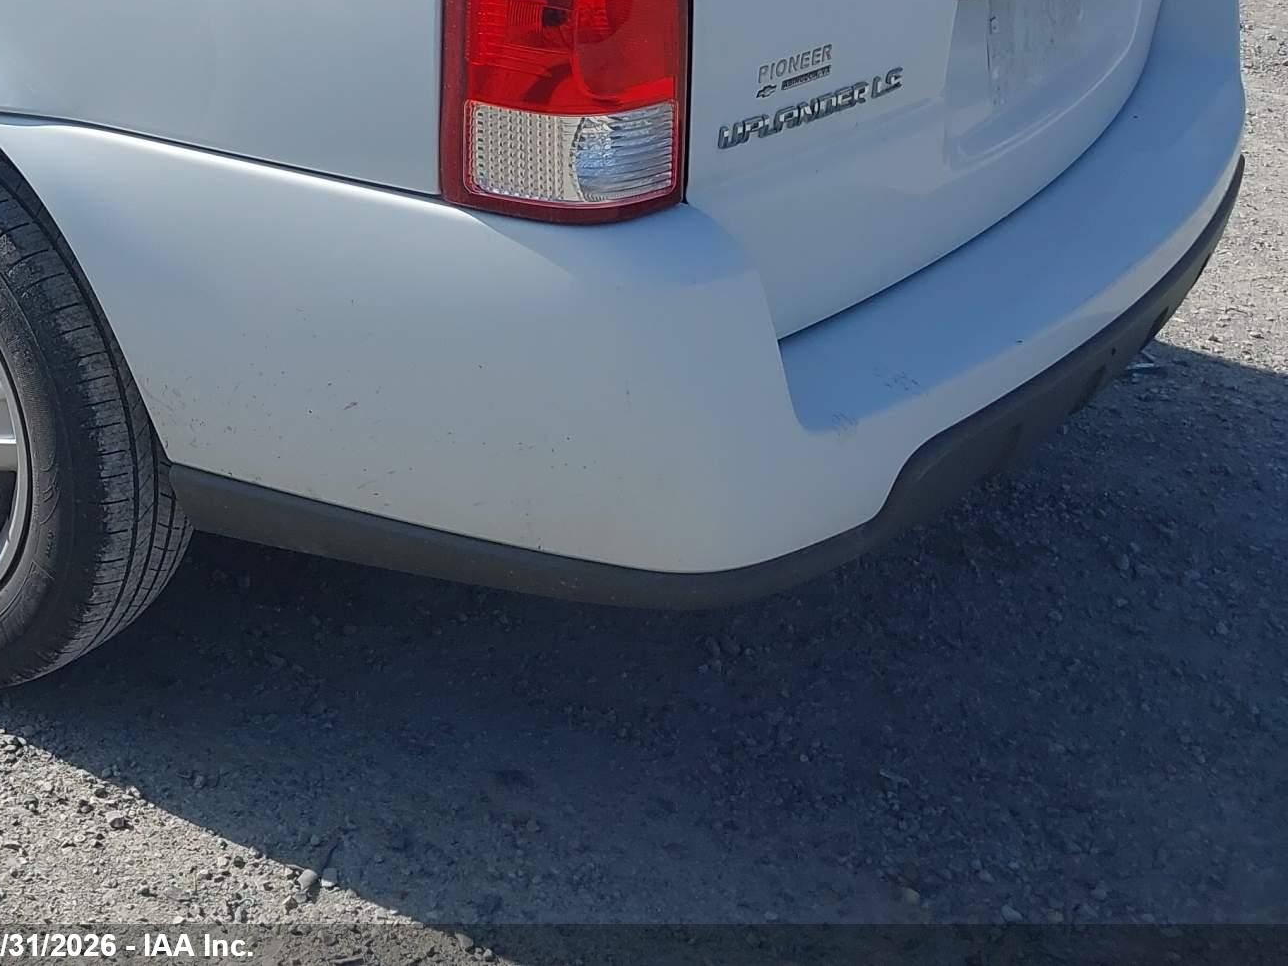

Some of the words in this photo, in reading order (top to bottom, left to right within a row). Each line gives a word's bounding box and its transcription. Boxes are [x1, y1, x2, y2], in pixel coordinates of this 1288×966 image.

[758, 44, 832, 83] PIONEER
[718, 82, 869, 149] UPLANDER
[870, 67, 904, 99] LS
